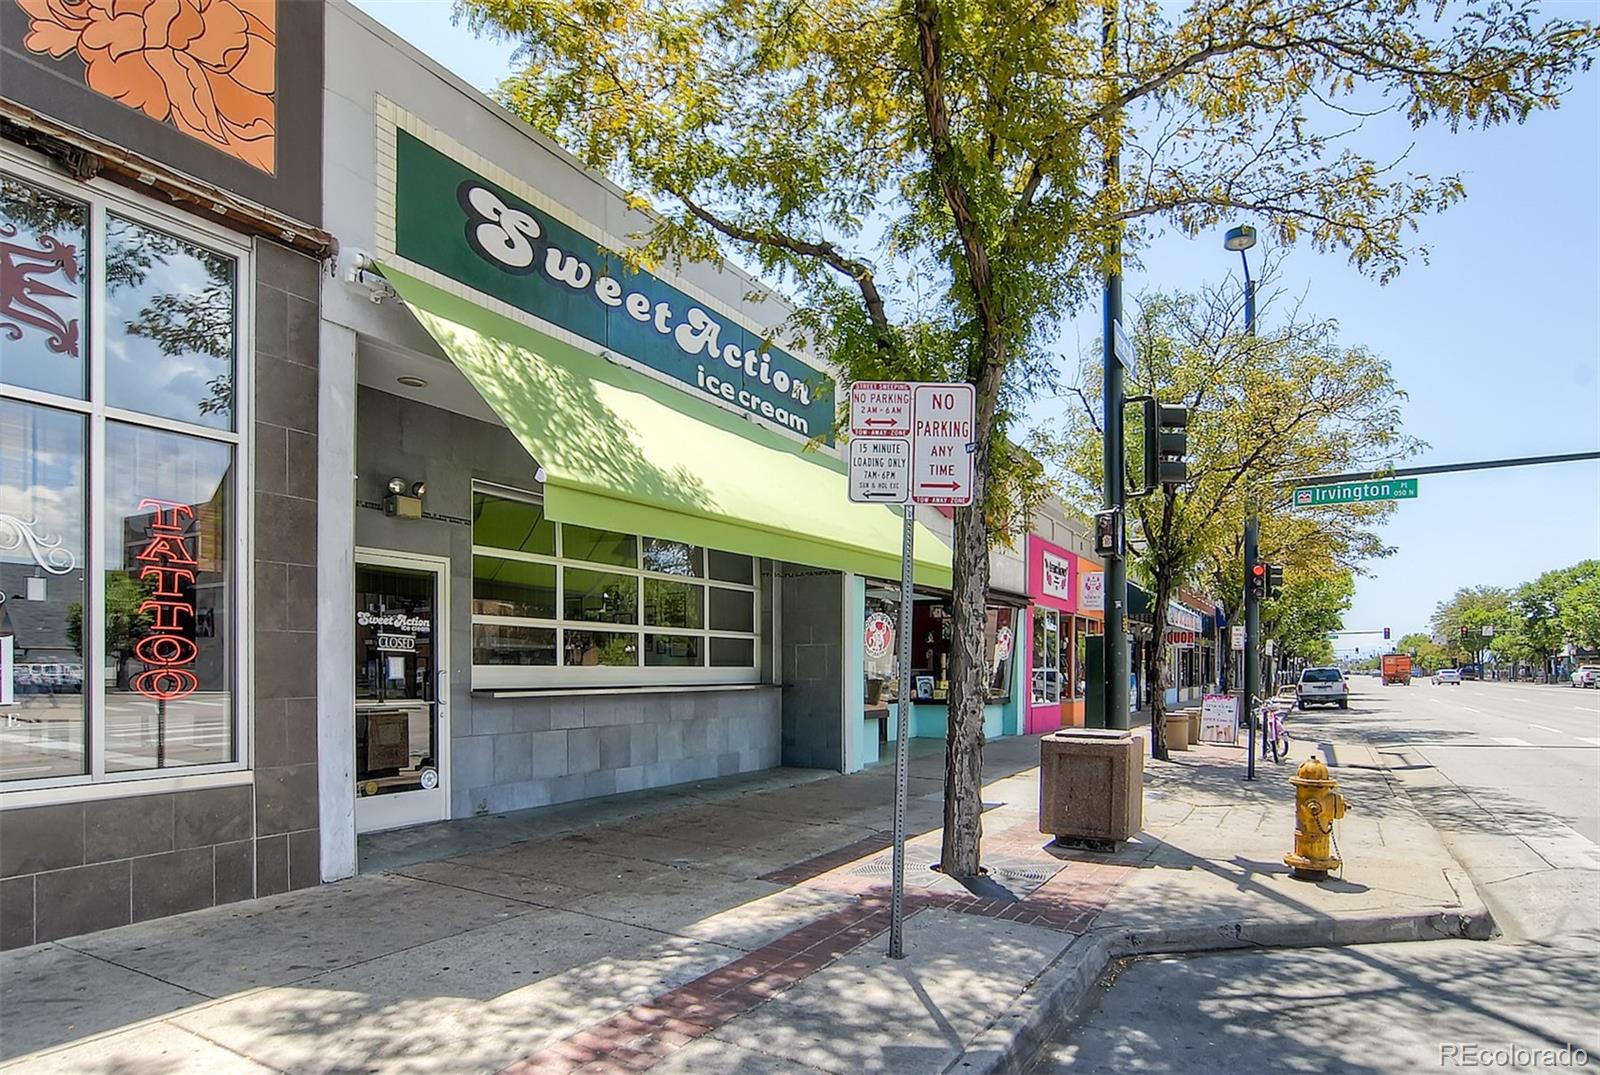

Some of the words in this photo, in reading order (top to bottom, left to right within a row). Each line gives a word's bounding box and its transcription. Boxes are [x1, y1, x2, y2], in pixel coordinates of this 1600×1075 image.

[467, 186, 672, 335] Sweet
[674, 307, 811, 406] Action
[697, 365, 734, 401] ice
[738, 389, 809, 435] cream
[855, 393, 866, 403] NO
[870, 393, 909, 404] PARKING
[932, 394, 954, 410] NO
[916, 420, 969, 437] PARKING
[859, 443, 867, 453] 15
[872, 444, 901, 454] MINUTE
[930, 445, 954, 457] ANY
[853, 457, 884, 467] LOADING
[887, 458, 906, 468] ONLY
[929, 464, 955, 476] TIME
[1316, 484, 1390, 501] Irvington
[135, 498, 198, 700] TATTOO
[357, 611, 394, 626] Sweet
[393, 614, 430, 628] Action
[378, 636, 415, 649] CLOSED
[1167, 631, 1194, 645] QUOR
